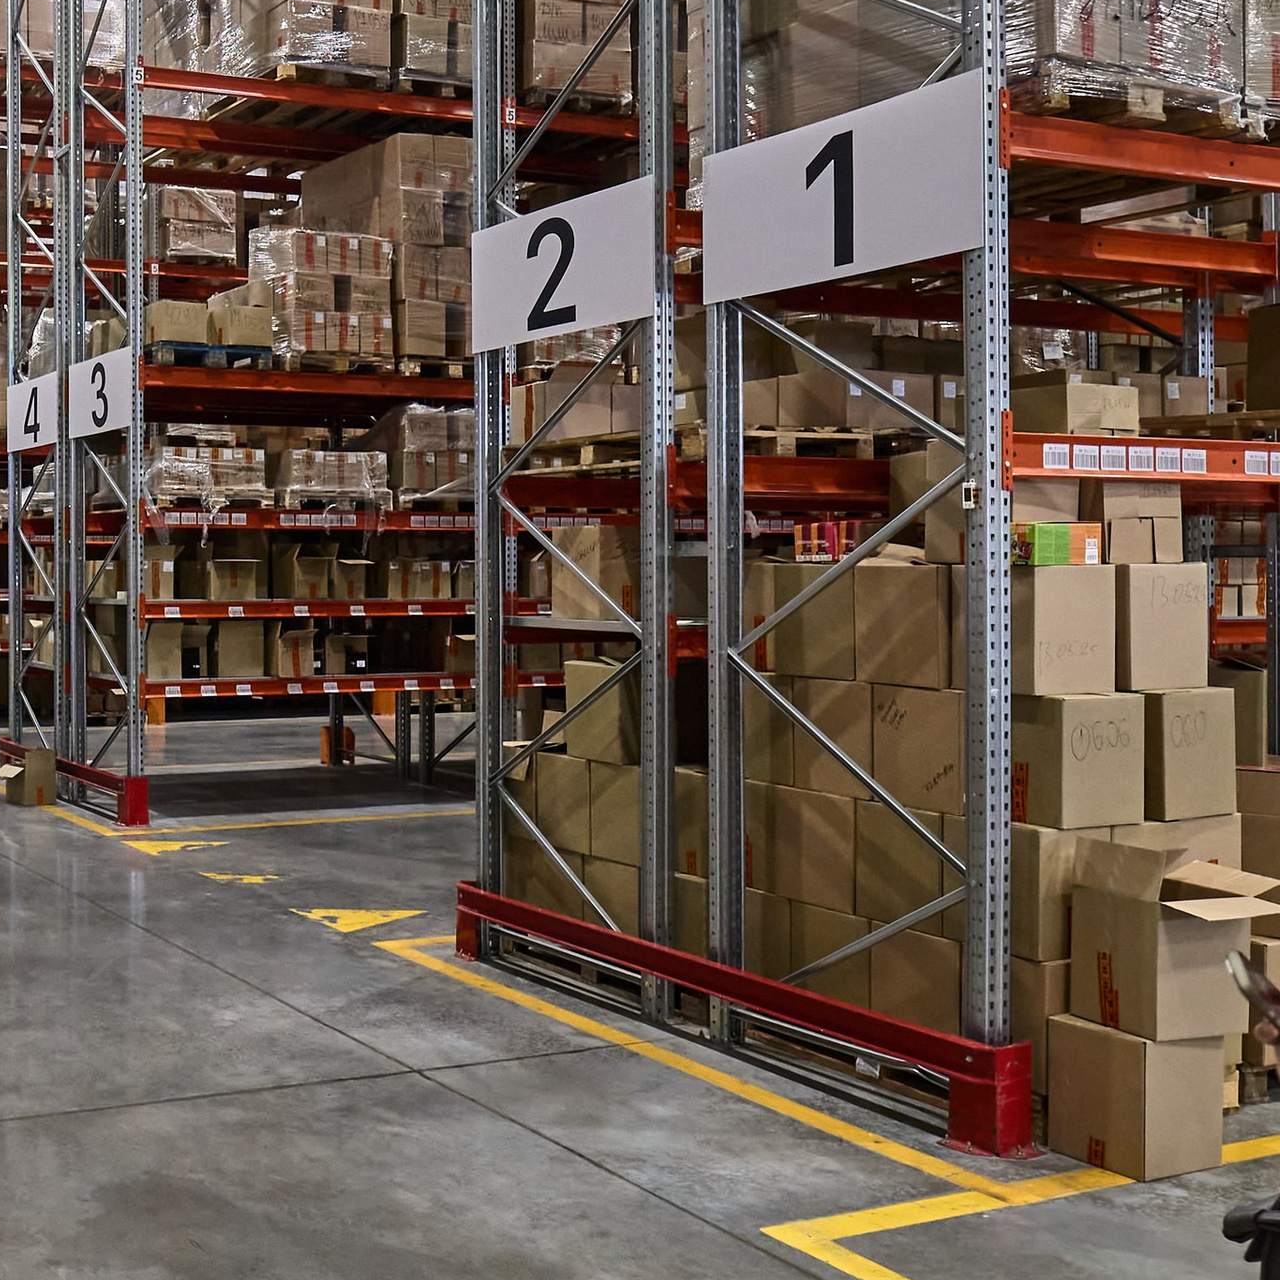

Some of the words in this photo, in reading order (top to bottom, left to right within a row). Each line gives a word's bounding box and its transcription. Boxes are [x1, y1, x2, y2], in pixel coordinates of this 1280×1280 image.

[135, 69, 143, 81] 5
[508, 110, 515, 122] 5
[805, 129, 854, 268] 1
[526, 216, 577, 331] 2
[23, 386, 41, 443] 4
[90, 362, 109, 428] 3
